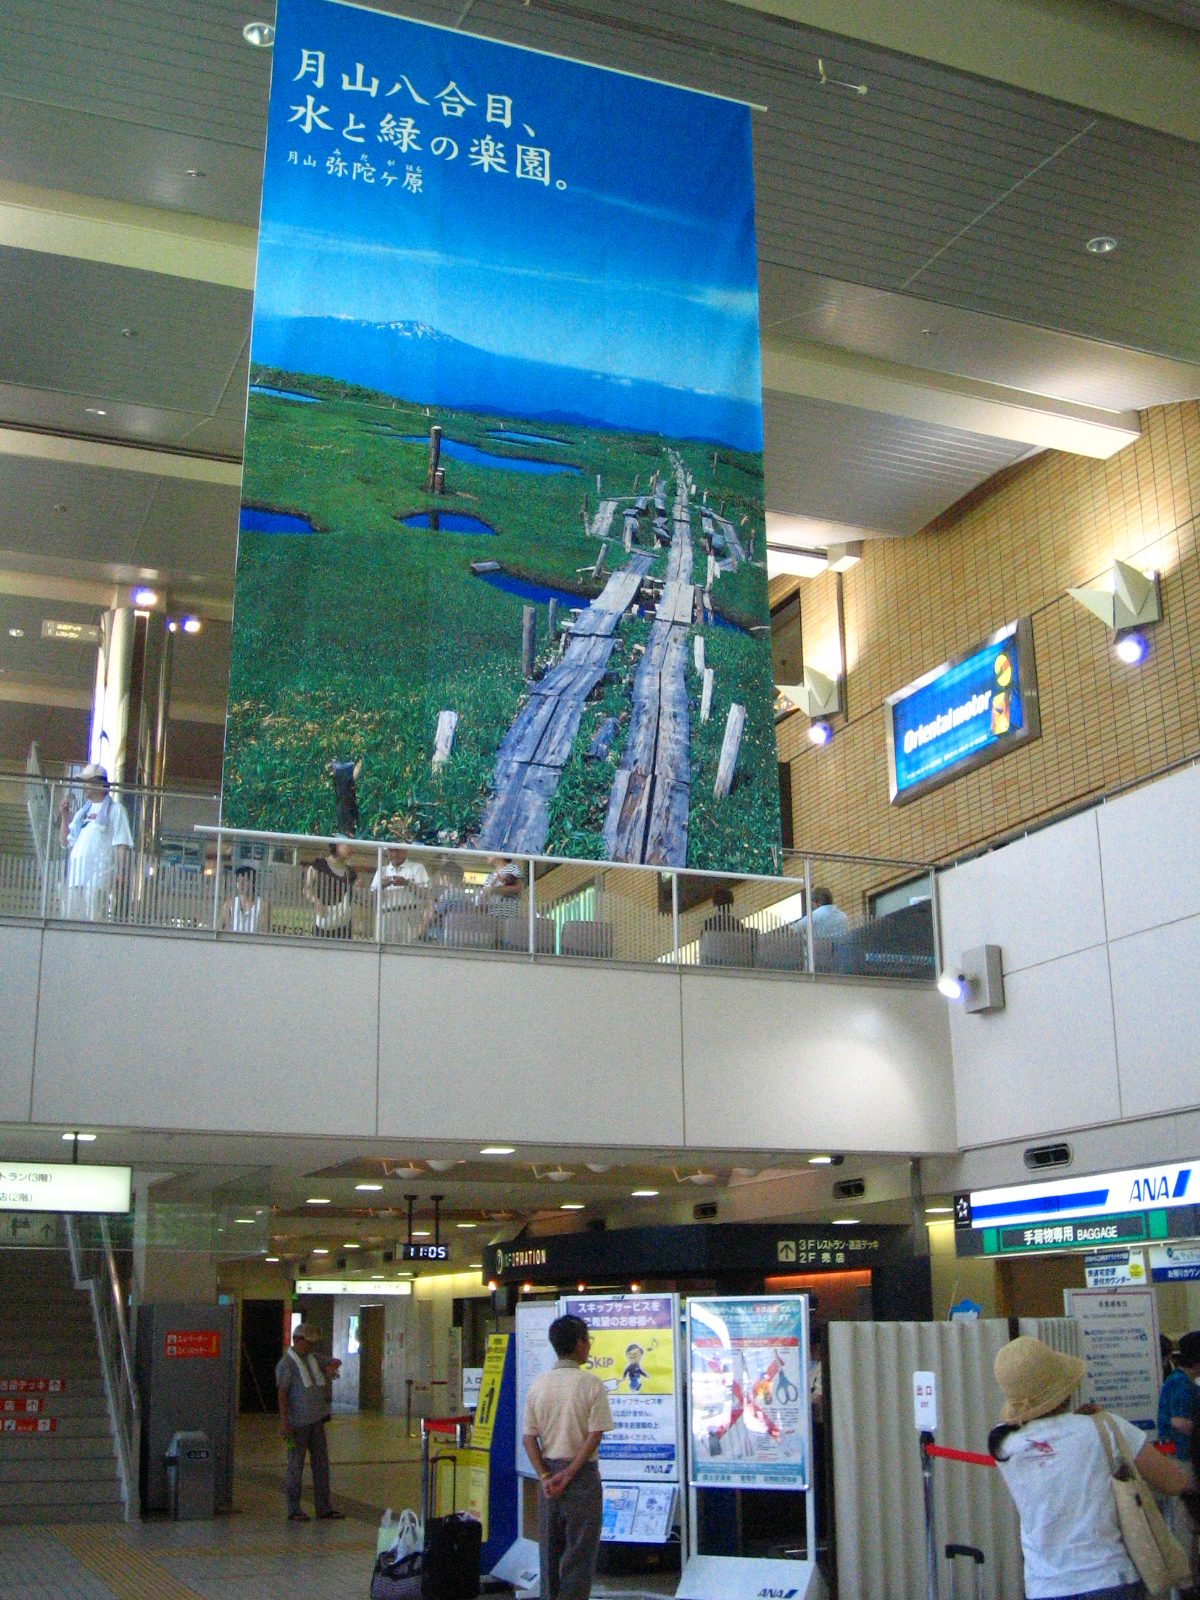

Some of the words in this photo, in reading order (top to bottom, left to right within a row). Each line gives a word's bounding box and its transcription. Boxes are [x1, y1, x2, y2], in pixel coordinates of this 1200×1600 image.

[293, 48, 536, 138] 月山八合目、
[287, 95, 567, 190] 水と緑の楽園。
[287, 151, 316, 168] 月山
[1129, 1176, 1169, 1203] ANA
[1024, 1225, 1074, 1245] 手荷物専用
[1077, 1225, 1118, 1240] BAGGAGE
[409, 1246, 446, 1258] 11:05
[578, 1301, 660, 1313] スキップサービスを
[644, 1464, 664, 1474] ANA
[758, 1588, 783, 1598] ANA
